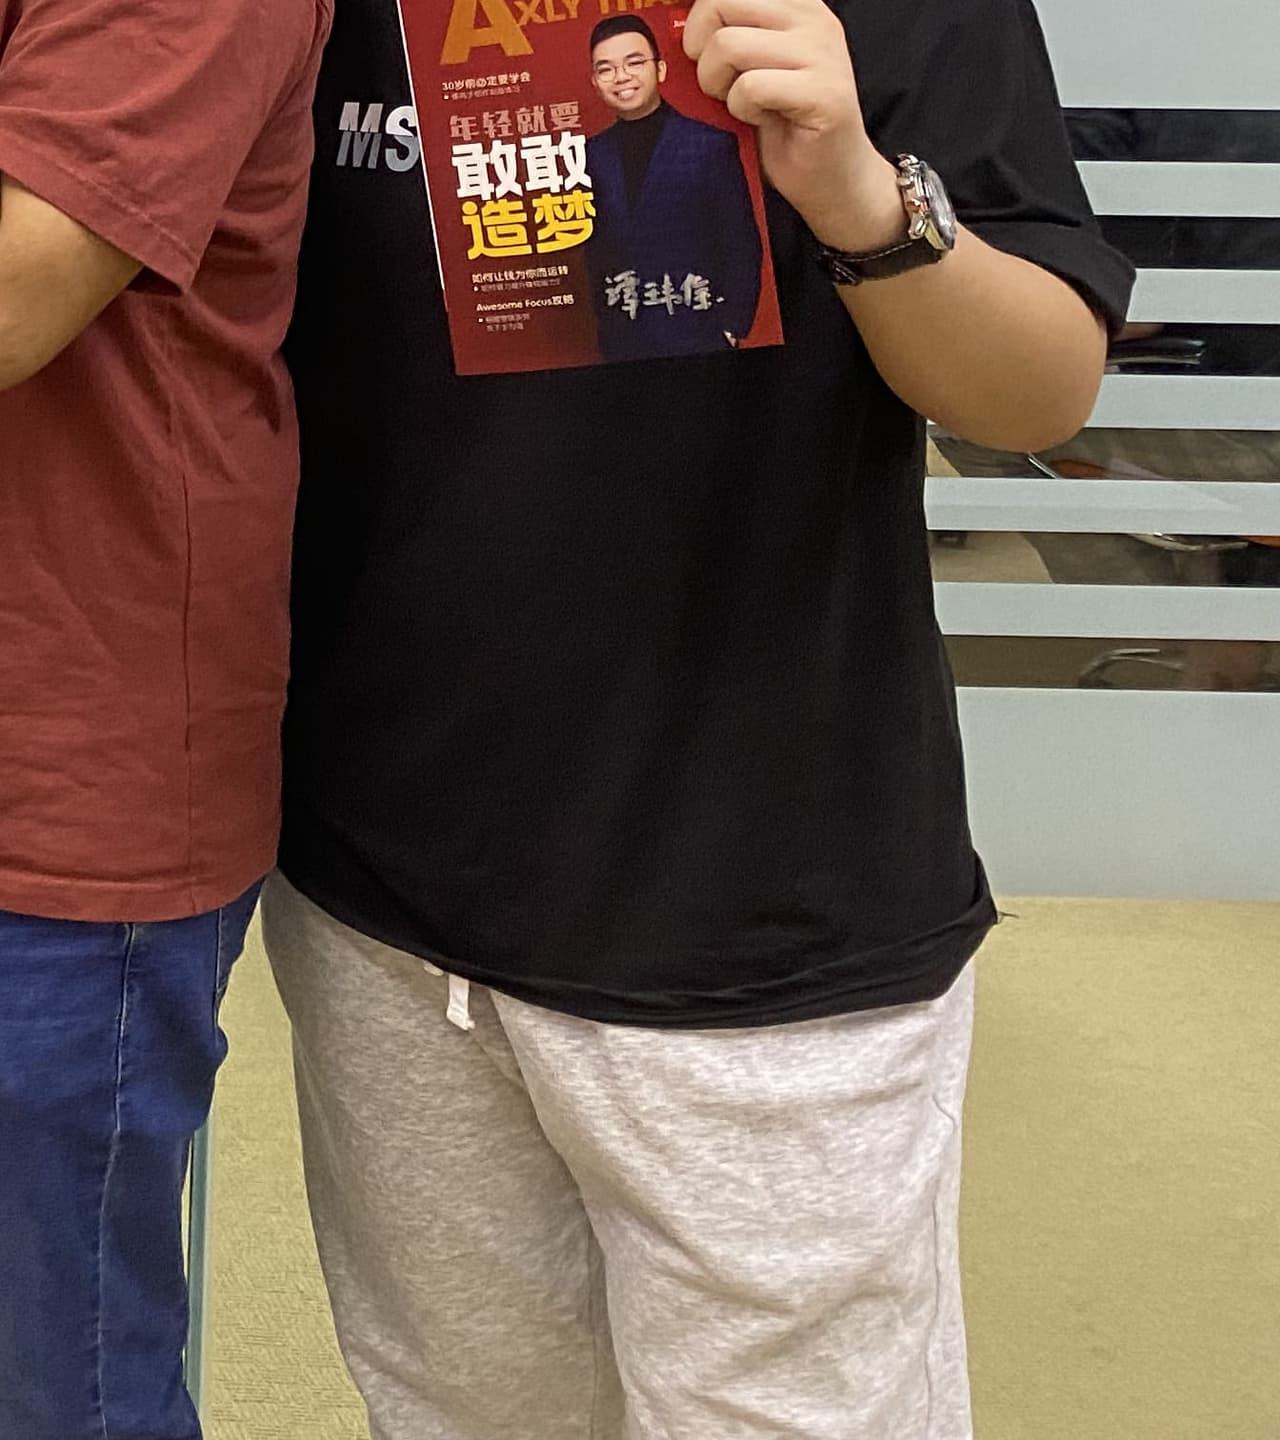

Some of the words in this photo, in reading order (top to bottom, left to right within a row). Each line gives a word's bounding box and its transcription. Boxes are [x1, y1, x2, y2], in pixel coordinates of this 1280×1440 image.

[449, 100, 582, 141] 年轻就要
[451, 130, 593, 201] 敢敢
[461, 189, 597, 261] 造梦
[476, 300, 523, 312] Awesome
